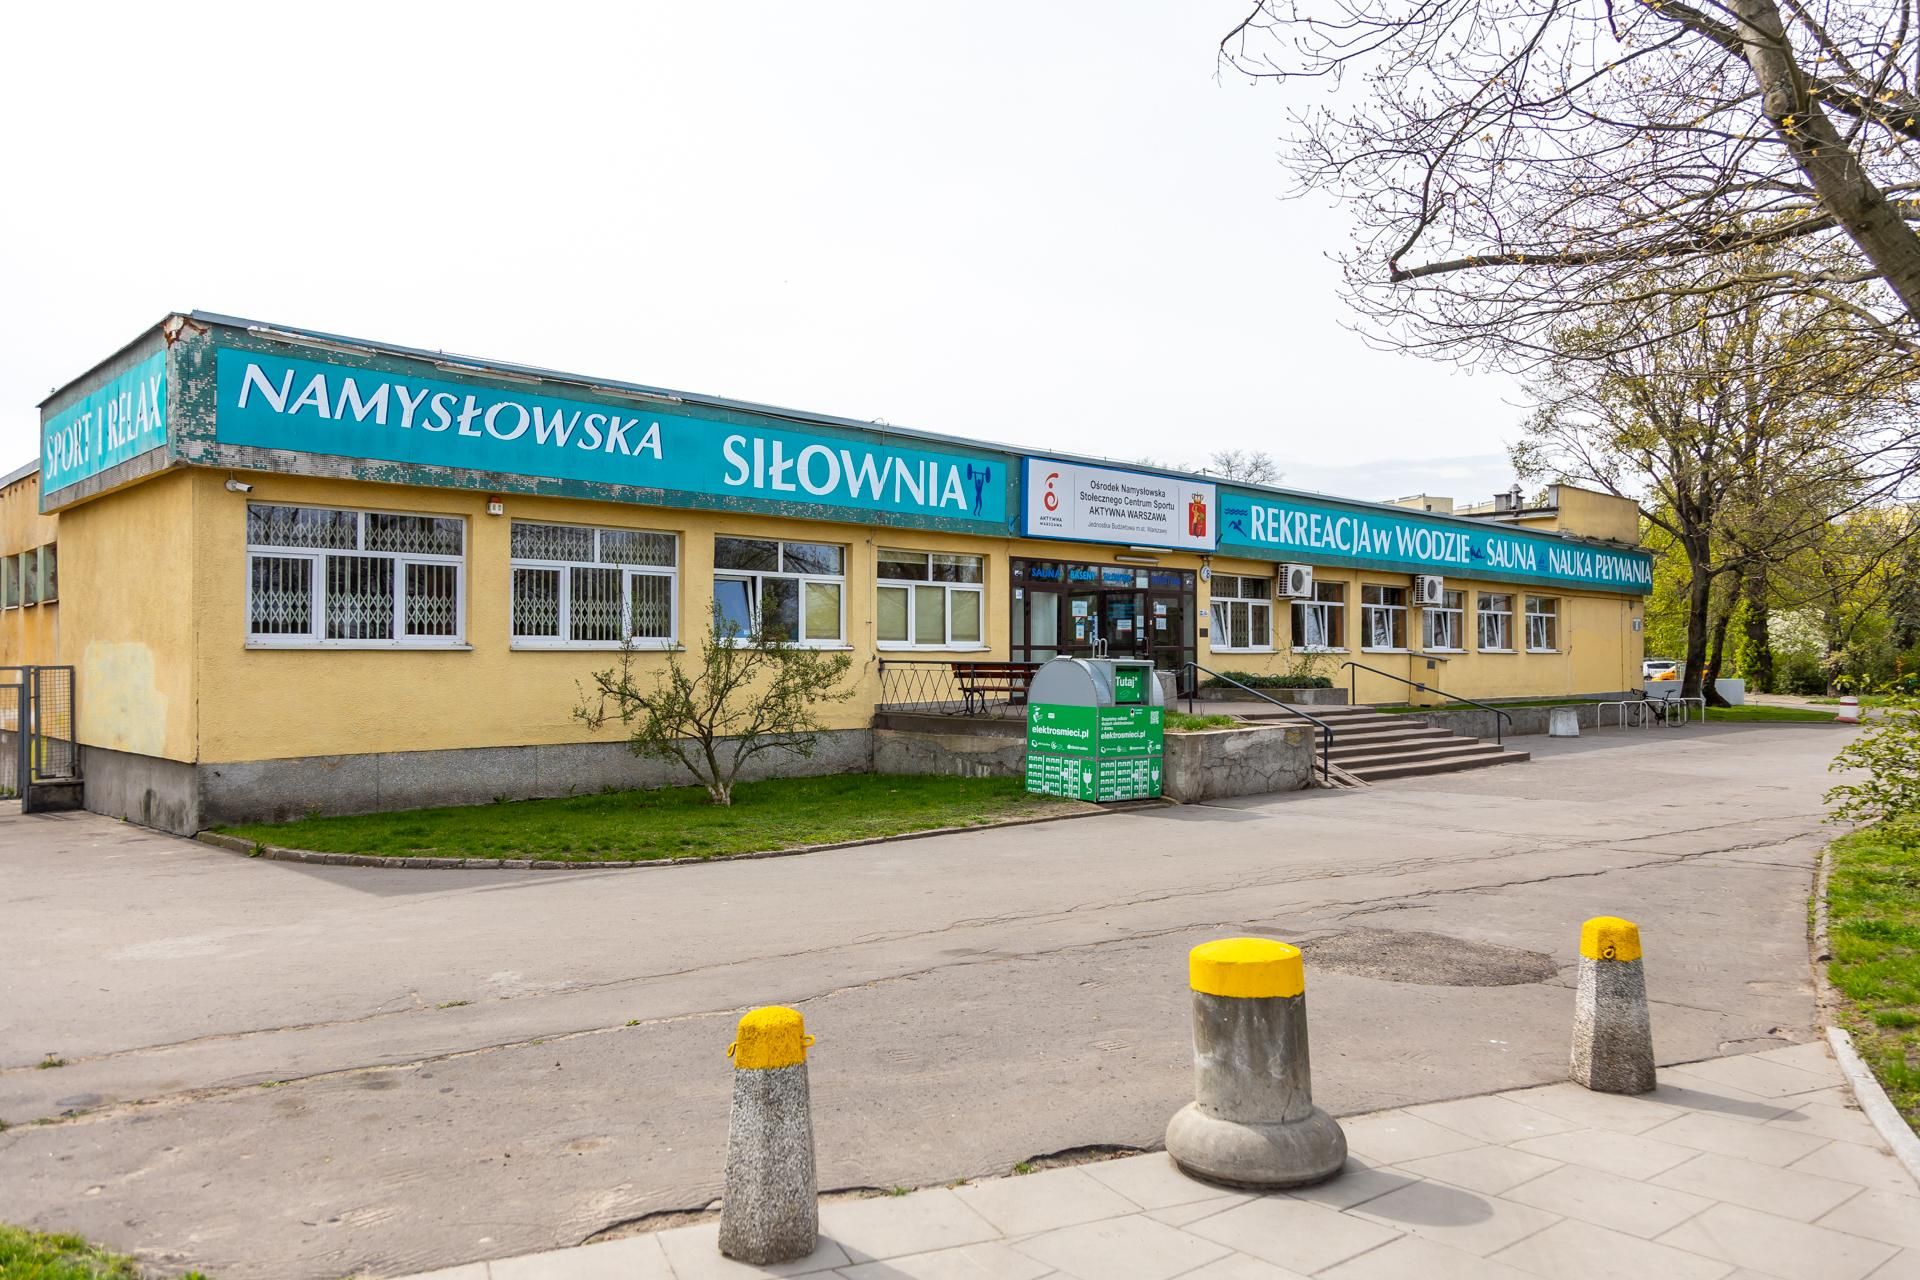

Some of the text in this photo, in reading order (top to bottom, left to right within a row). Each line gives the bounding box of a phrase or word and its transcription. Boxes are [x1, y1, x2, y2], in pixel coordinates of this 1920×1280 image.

[46, 372, 162, 481] SPORT I RELAX
[237, 363, 968, 510] NAMYSŁOWSKA SIŁOWNIA
[1090, 480, 1166, 498] Ośrodek Namysłowska
[1080, 491, 1175, 511] Stołecznego Centrum Sportu
[1089, 506, 1167, 522] AKTYWNA WARSZAWA
[1251, 505, 1371, 555] REKREACJA
[1395, 525, 1470, 563] WODZIE
[1486, 538, 1536, 572] SAUNA
[1549, 547, 1593, 578] NAUKA
[1595, 554, 1652, 584] PŁYWANIA
[1032, 725, 1089, 740] elektrosmieci.pl
